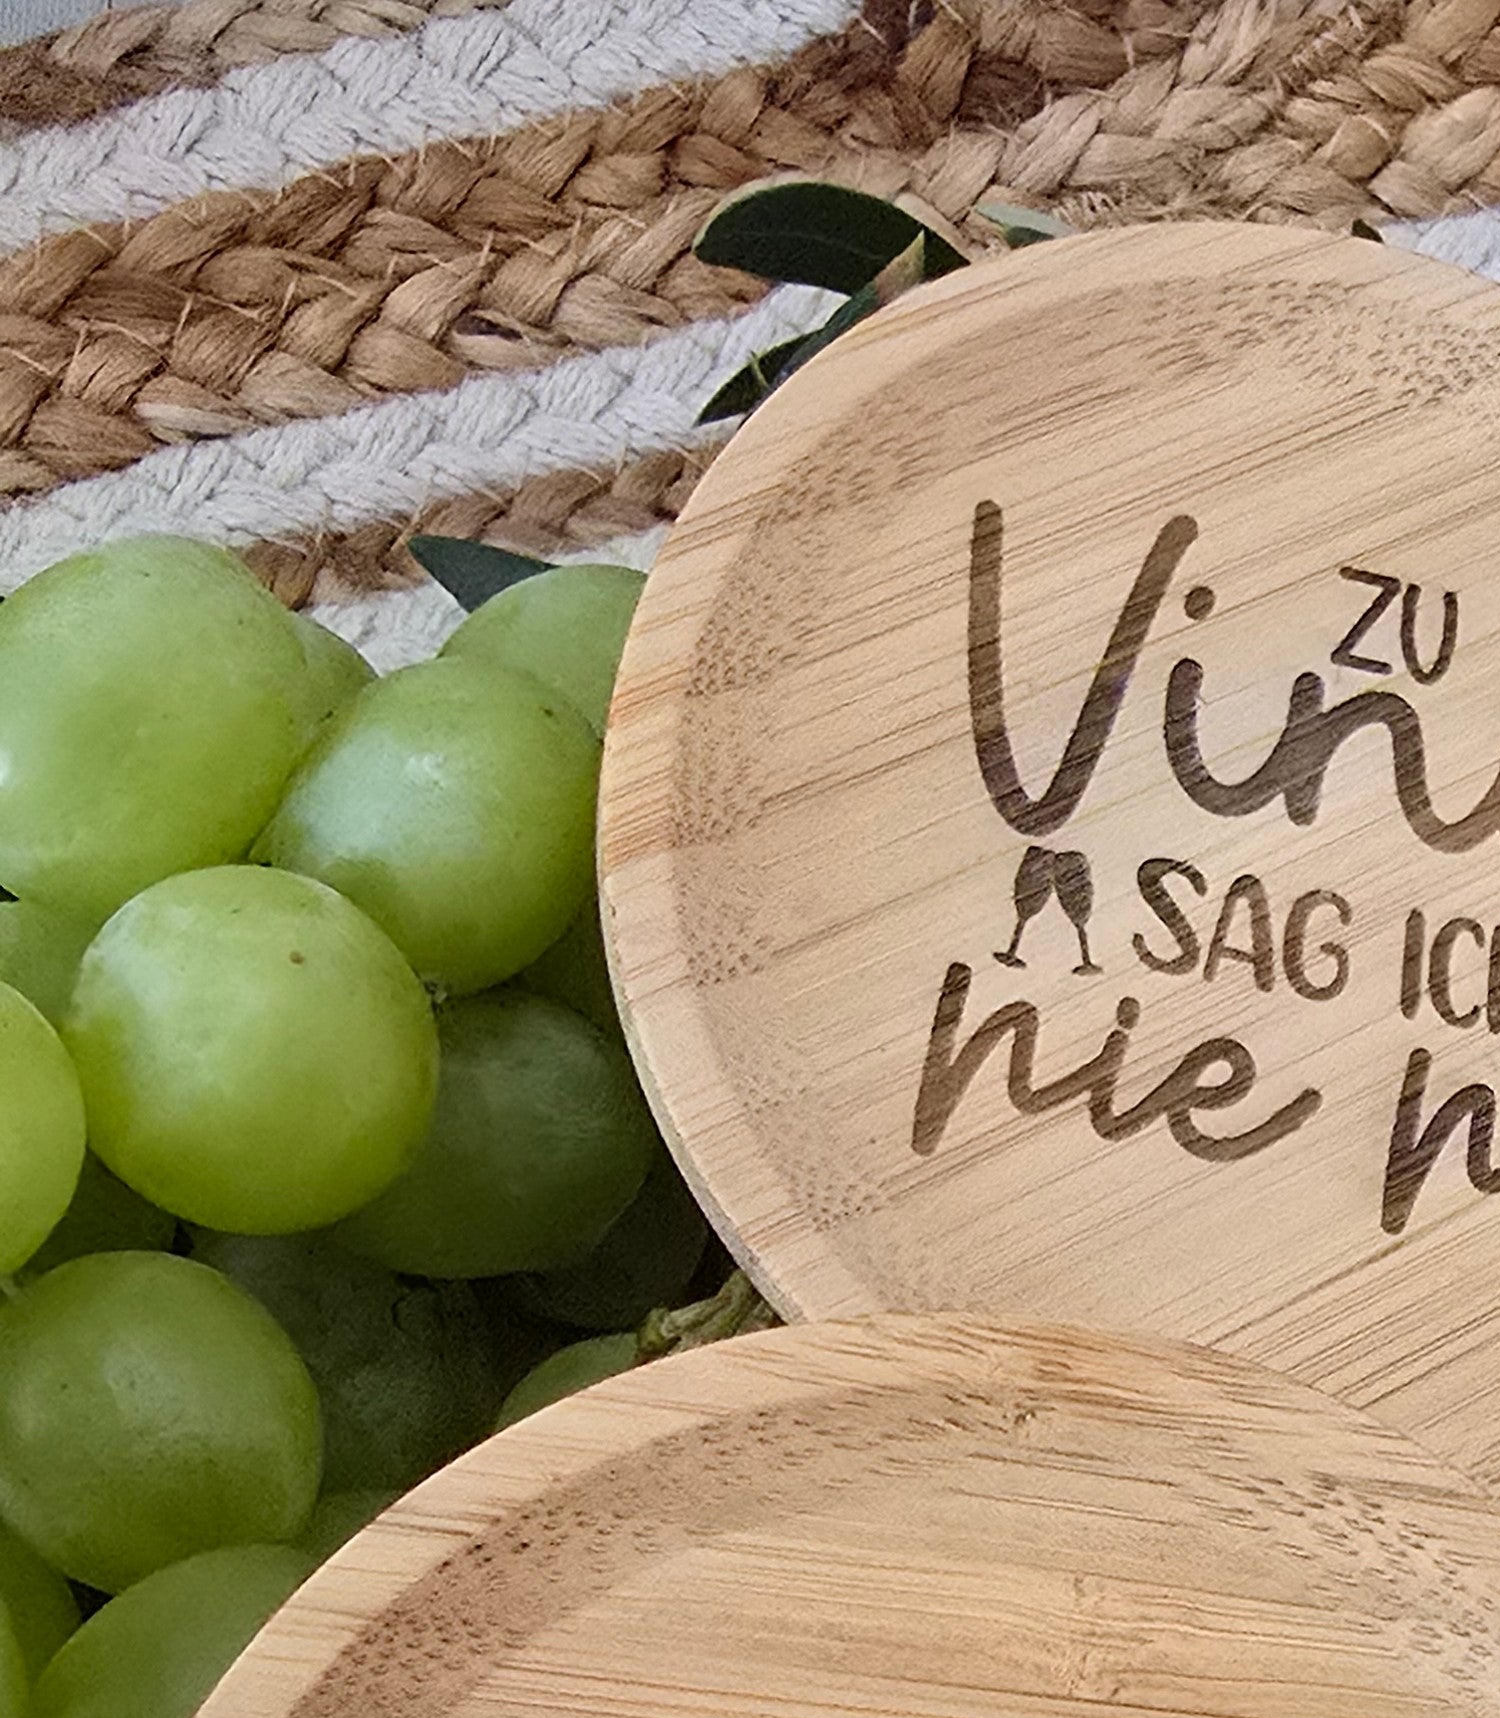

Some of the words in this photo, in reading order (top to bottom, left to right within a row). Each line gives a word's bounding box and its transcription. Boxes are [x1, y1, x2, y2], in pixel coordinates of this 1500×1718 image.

[1331, 566, 1457, 685] ZU
[1132, 857, 1353, 1001] SAG
[911, 961, 1323, 1163] nie
